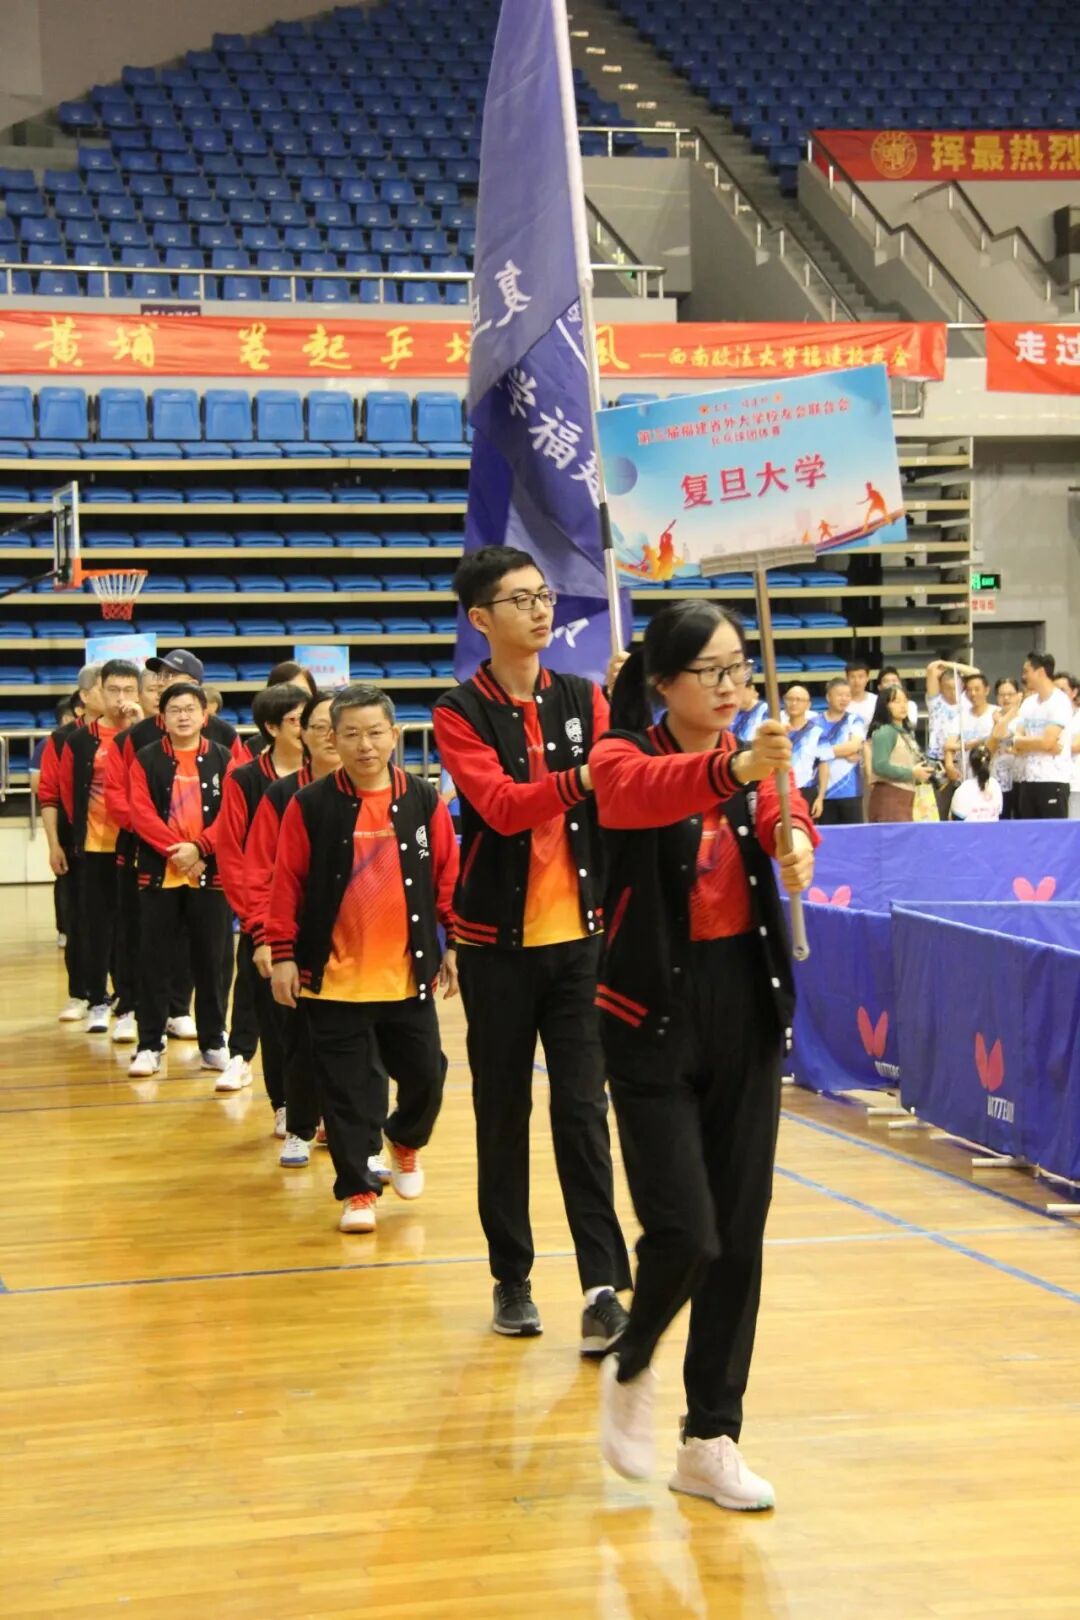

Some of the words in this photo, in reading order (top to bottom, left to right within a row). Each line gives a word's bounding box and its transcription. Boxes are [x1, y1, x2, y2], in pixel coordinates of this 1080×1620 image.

[931, 133, 1080, 172] 挥最热烈
[1015, 330, 1080, 367] 走过
[681, 454, 828, 509] 复旦大学
